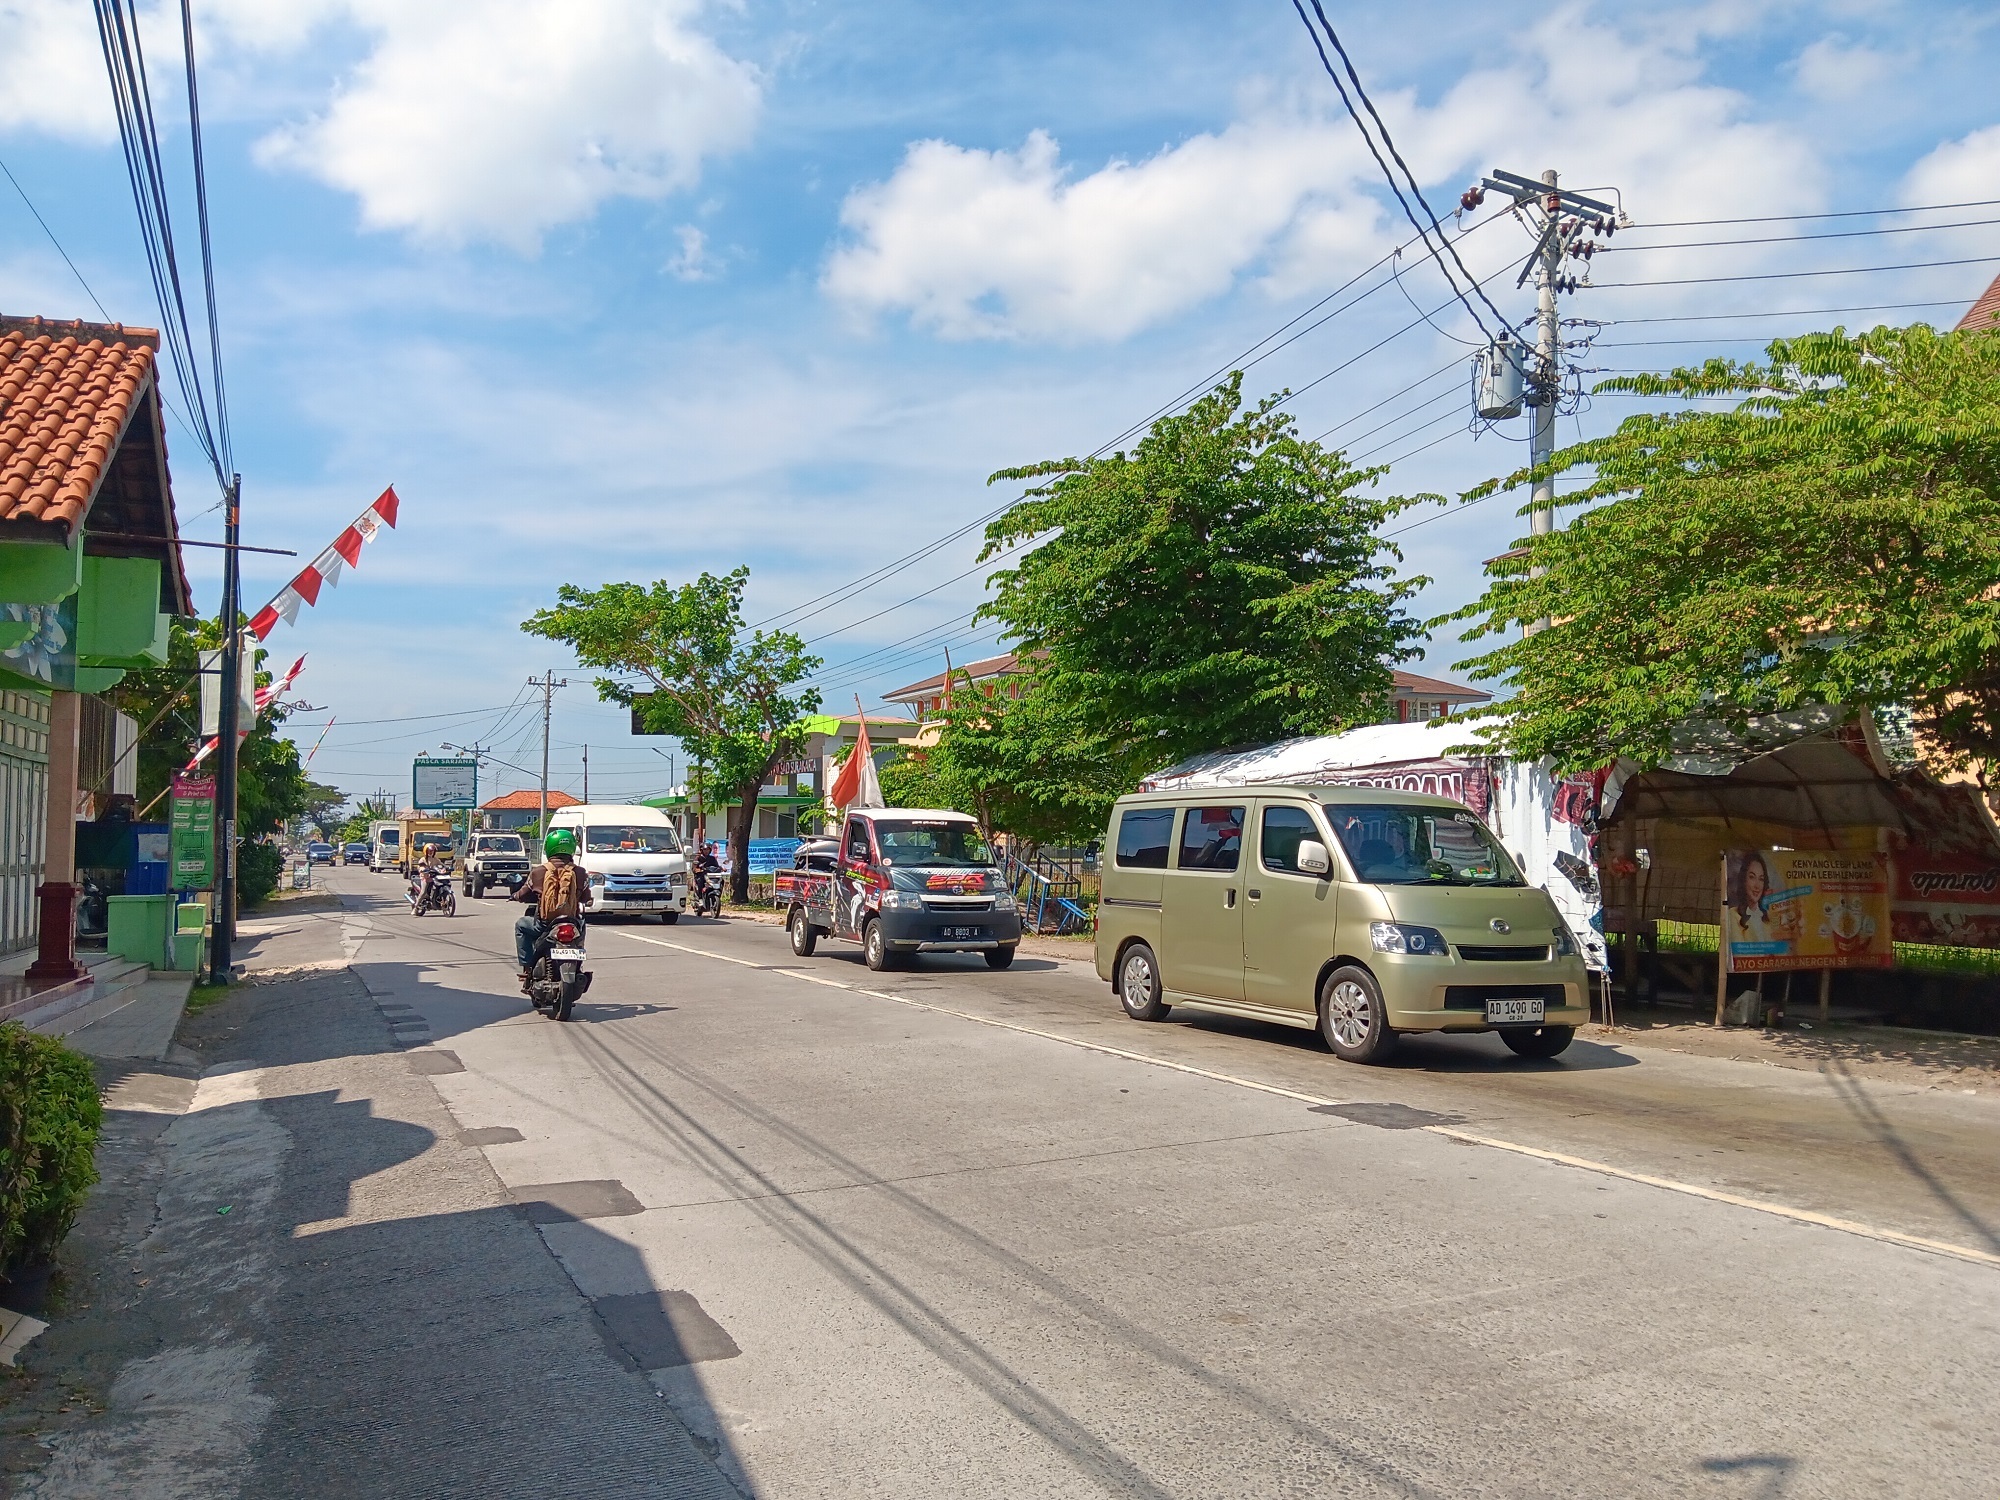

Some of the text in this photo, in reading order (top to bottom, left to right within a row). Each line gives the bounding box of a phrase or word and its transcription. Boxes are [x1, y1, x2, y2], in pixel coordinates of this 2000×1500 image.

[1792, 859, 1831, 869] KENYANG
[1831, 859, 1851, 869] LEBIH
[1786, 870, 1817, 880] GIZINYA
[1817, 870, 1841, 880] LEBIH
[1737, 959, 1755, 970] AYO
[1757, 958, 1796, 969] SARAPAN
[1490, 1001, 1542, 1015] AD 1490 GO
